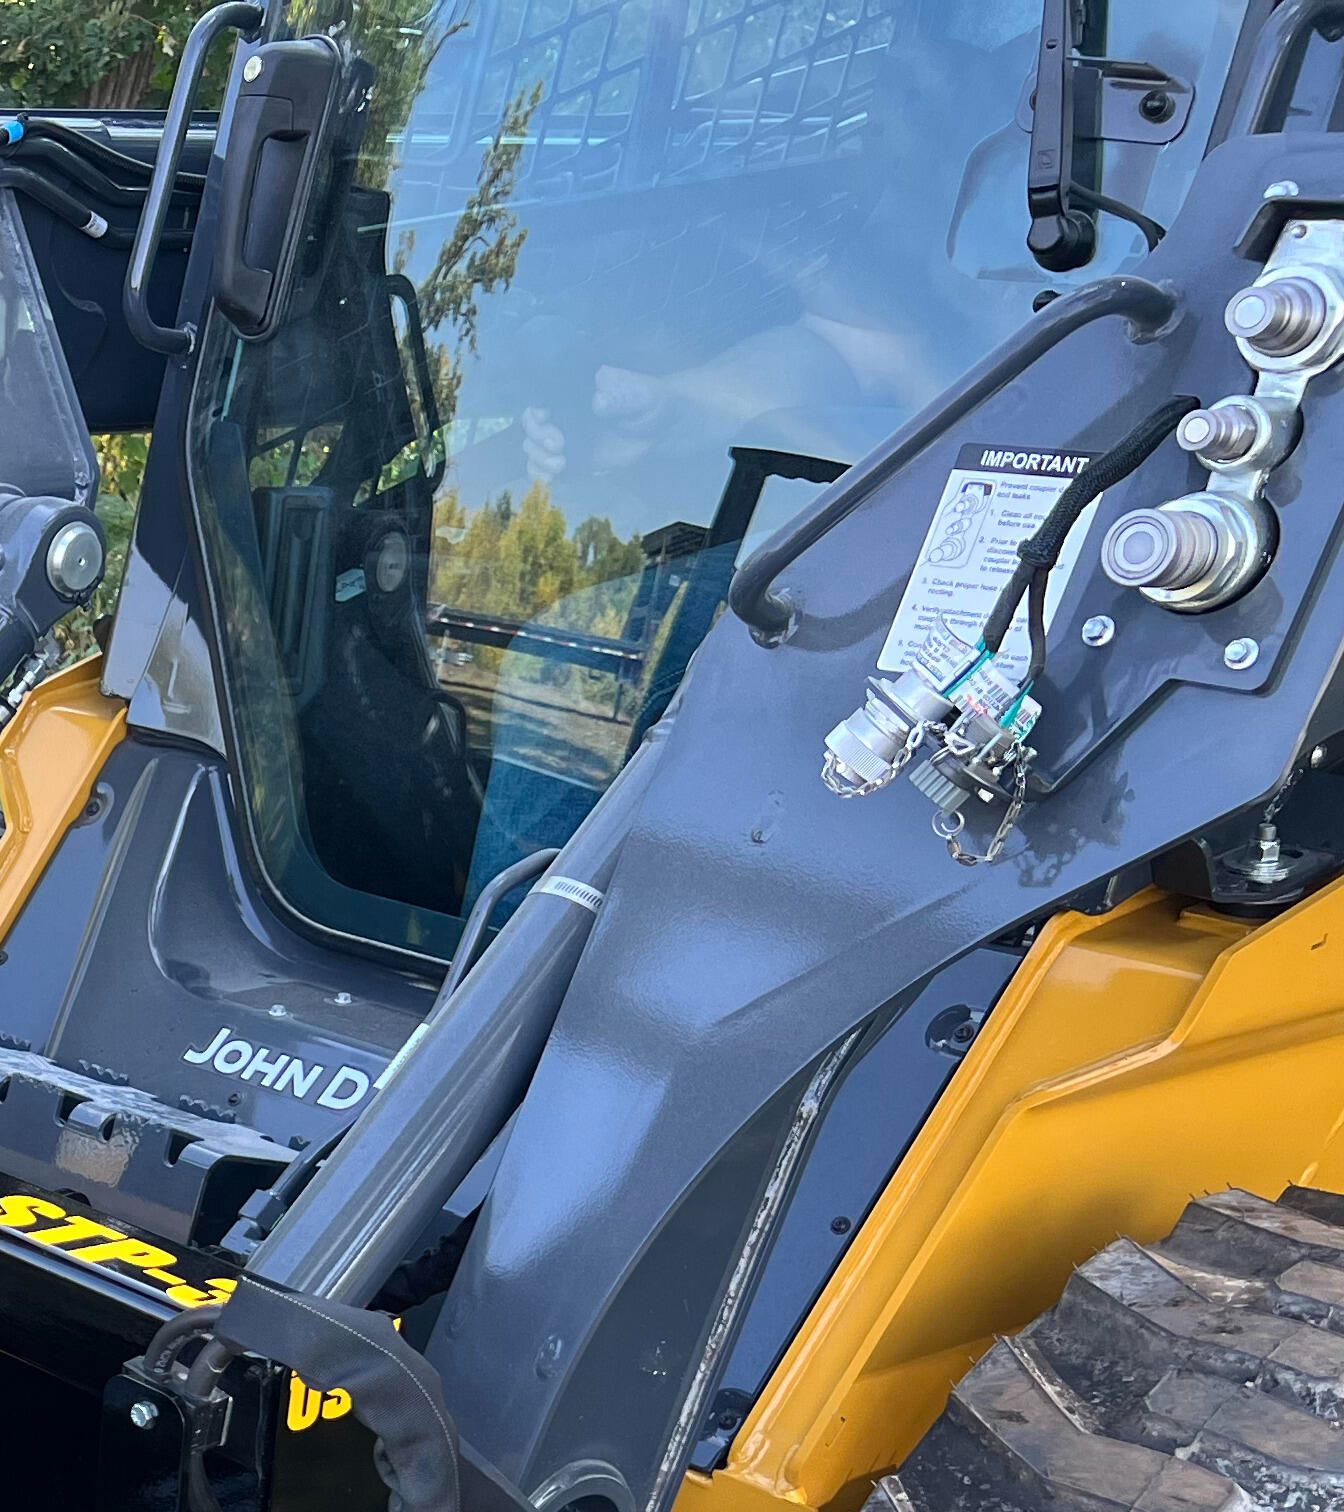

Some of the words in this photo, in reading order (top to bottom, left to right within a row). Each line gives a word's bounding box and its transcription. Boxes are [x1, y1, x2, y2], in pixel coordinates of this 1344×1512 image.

[980, 450, 1090, 474] IMPORTANT
[932, 578, 954, 587] Check
[955, 581, 980, 590] proper
[183, 1027, 324, 1099] JOHN
